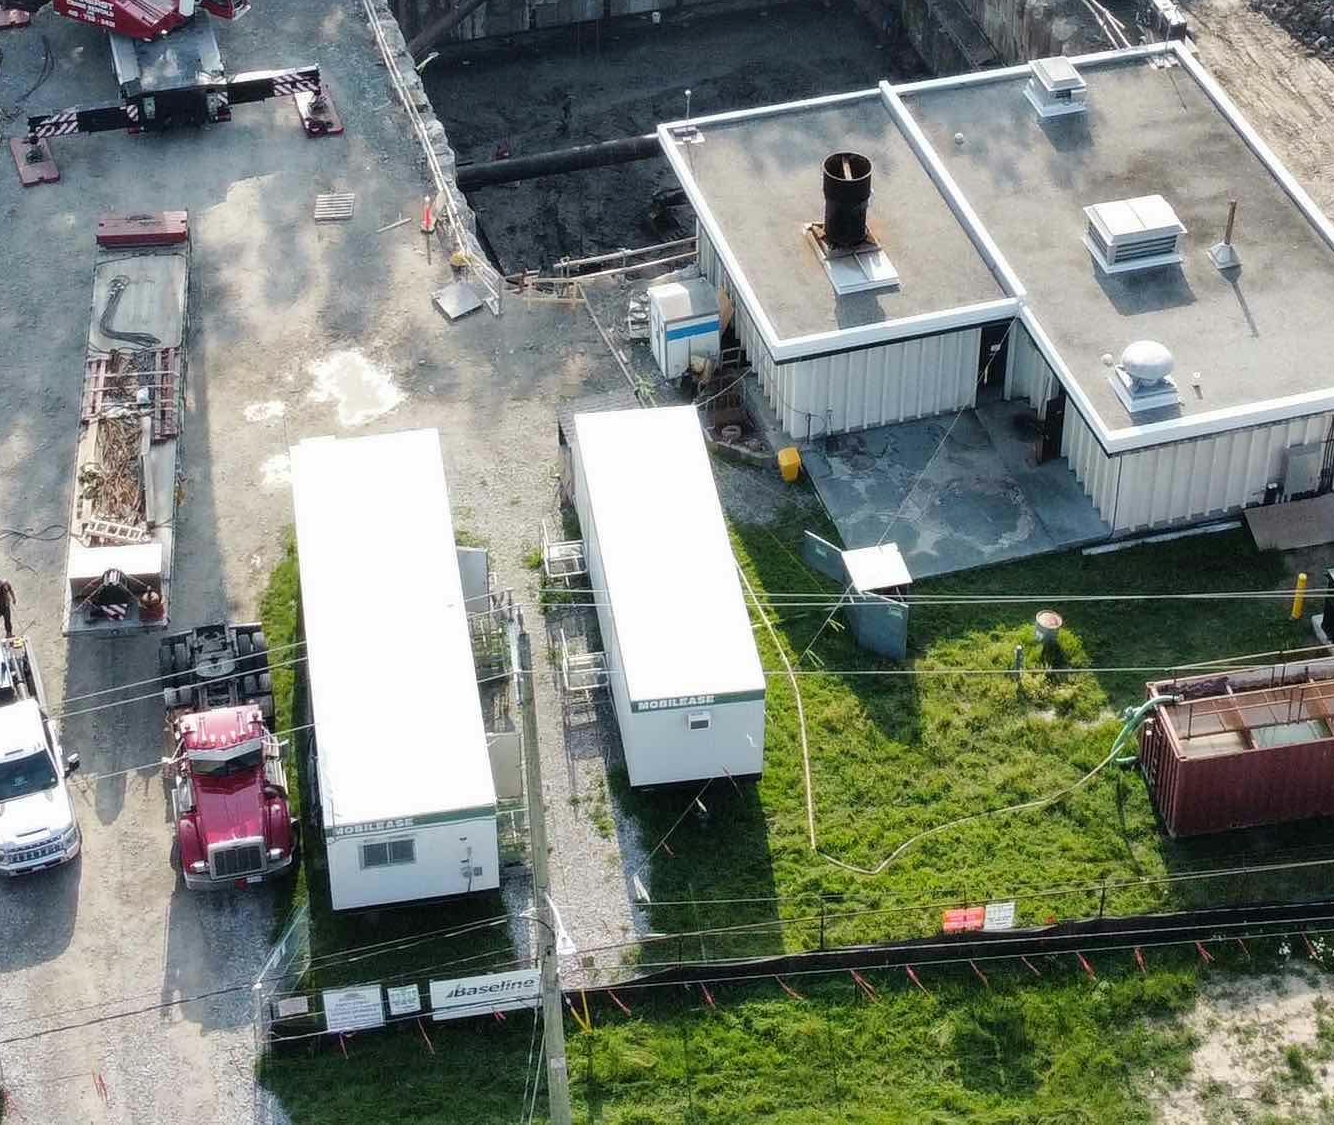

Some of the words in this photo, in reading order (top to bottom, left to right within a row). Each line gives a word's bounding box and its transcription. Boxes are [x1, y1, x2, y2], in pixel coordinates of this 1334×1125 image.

[637, 694, 716, 711] MOBILEASE
[334, 818, 414, 836] MOBILEASE
[453, 978, 536, 998] Baseline
